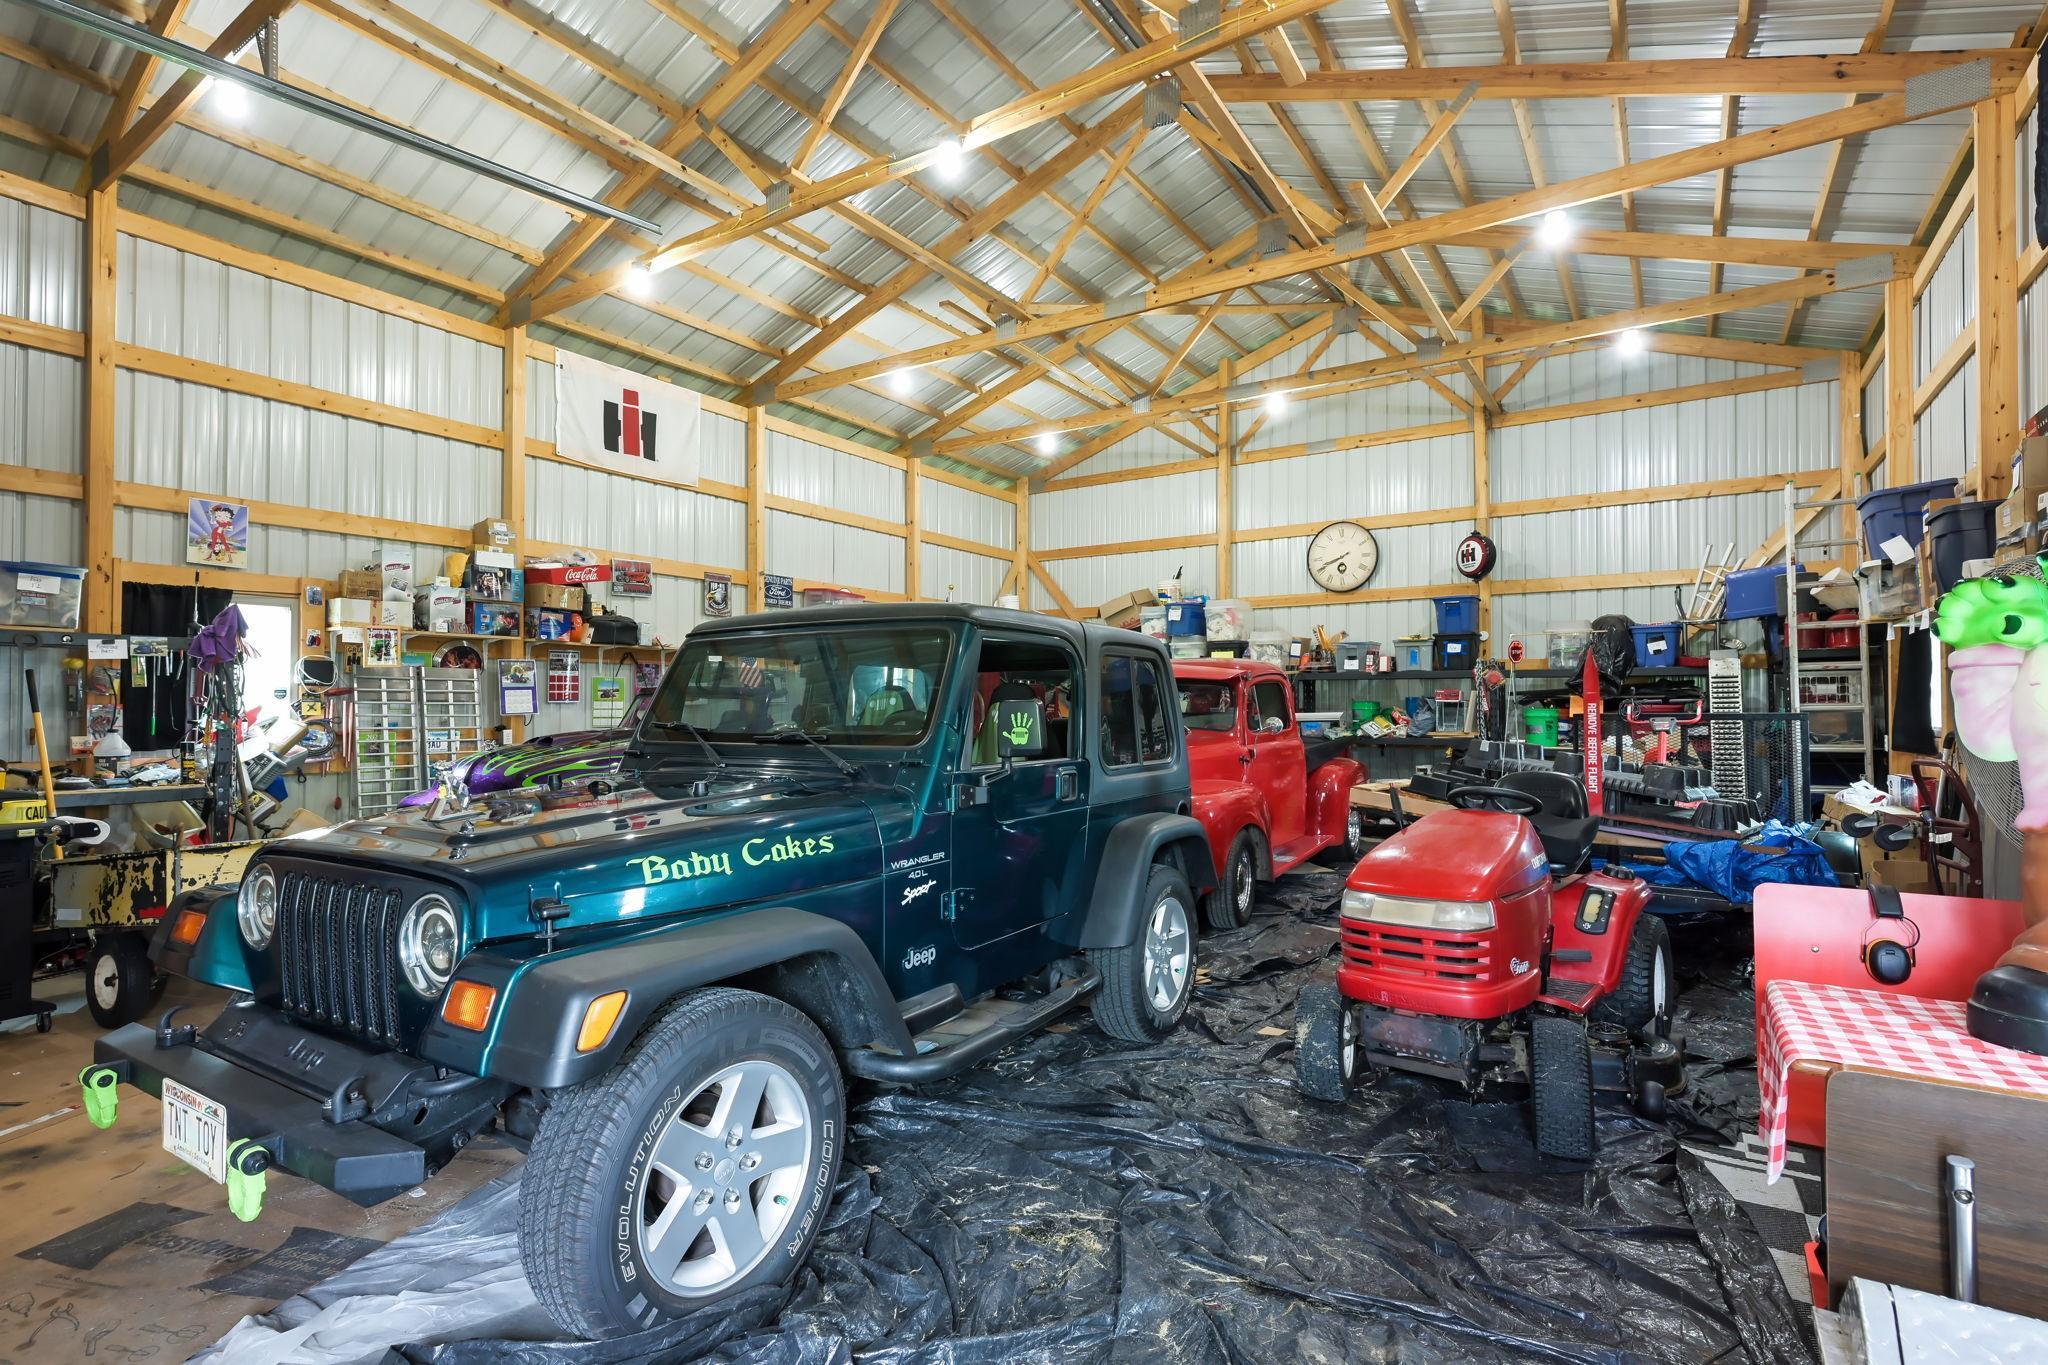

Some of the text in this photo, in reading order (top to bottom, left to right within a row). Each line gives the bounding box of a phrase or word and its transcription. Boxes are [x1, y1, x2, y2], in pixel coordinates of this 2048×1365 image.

[769, 585, 787, 597] Ford
[1587, 702, 1599, 794] REMOVE BEFORE FLIGHT
[626, 833, 836, 886] Baby Cakes
[890, 851, 946, 870] WRANGLER
[900, 879, 937, 906] Sport
[903, 945, 937, 971] Jeep
[168, 1101, 217, 1161] TNT TOY
[615, 1084, 682, 1284] EVOLUTION
[786, 1119, 834, 1258] COOPER
